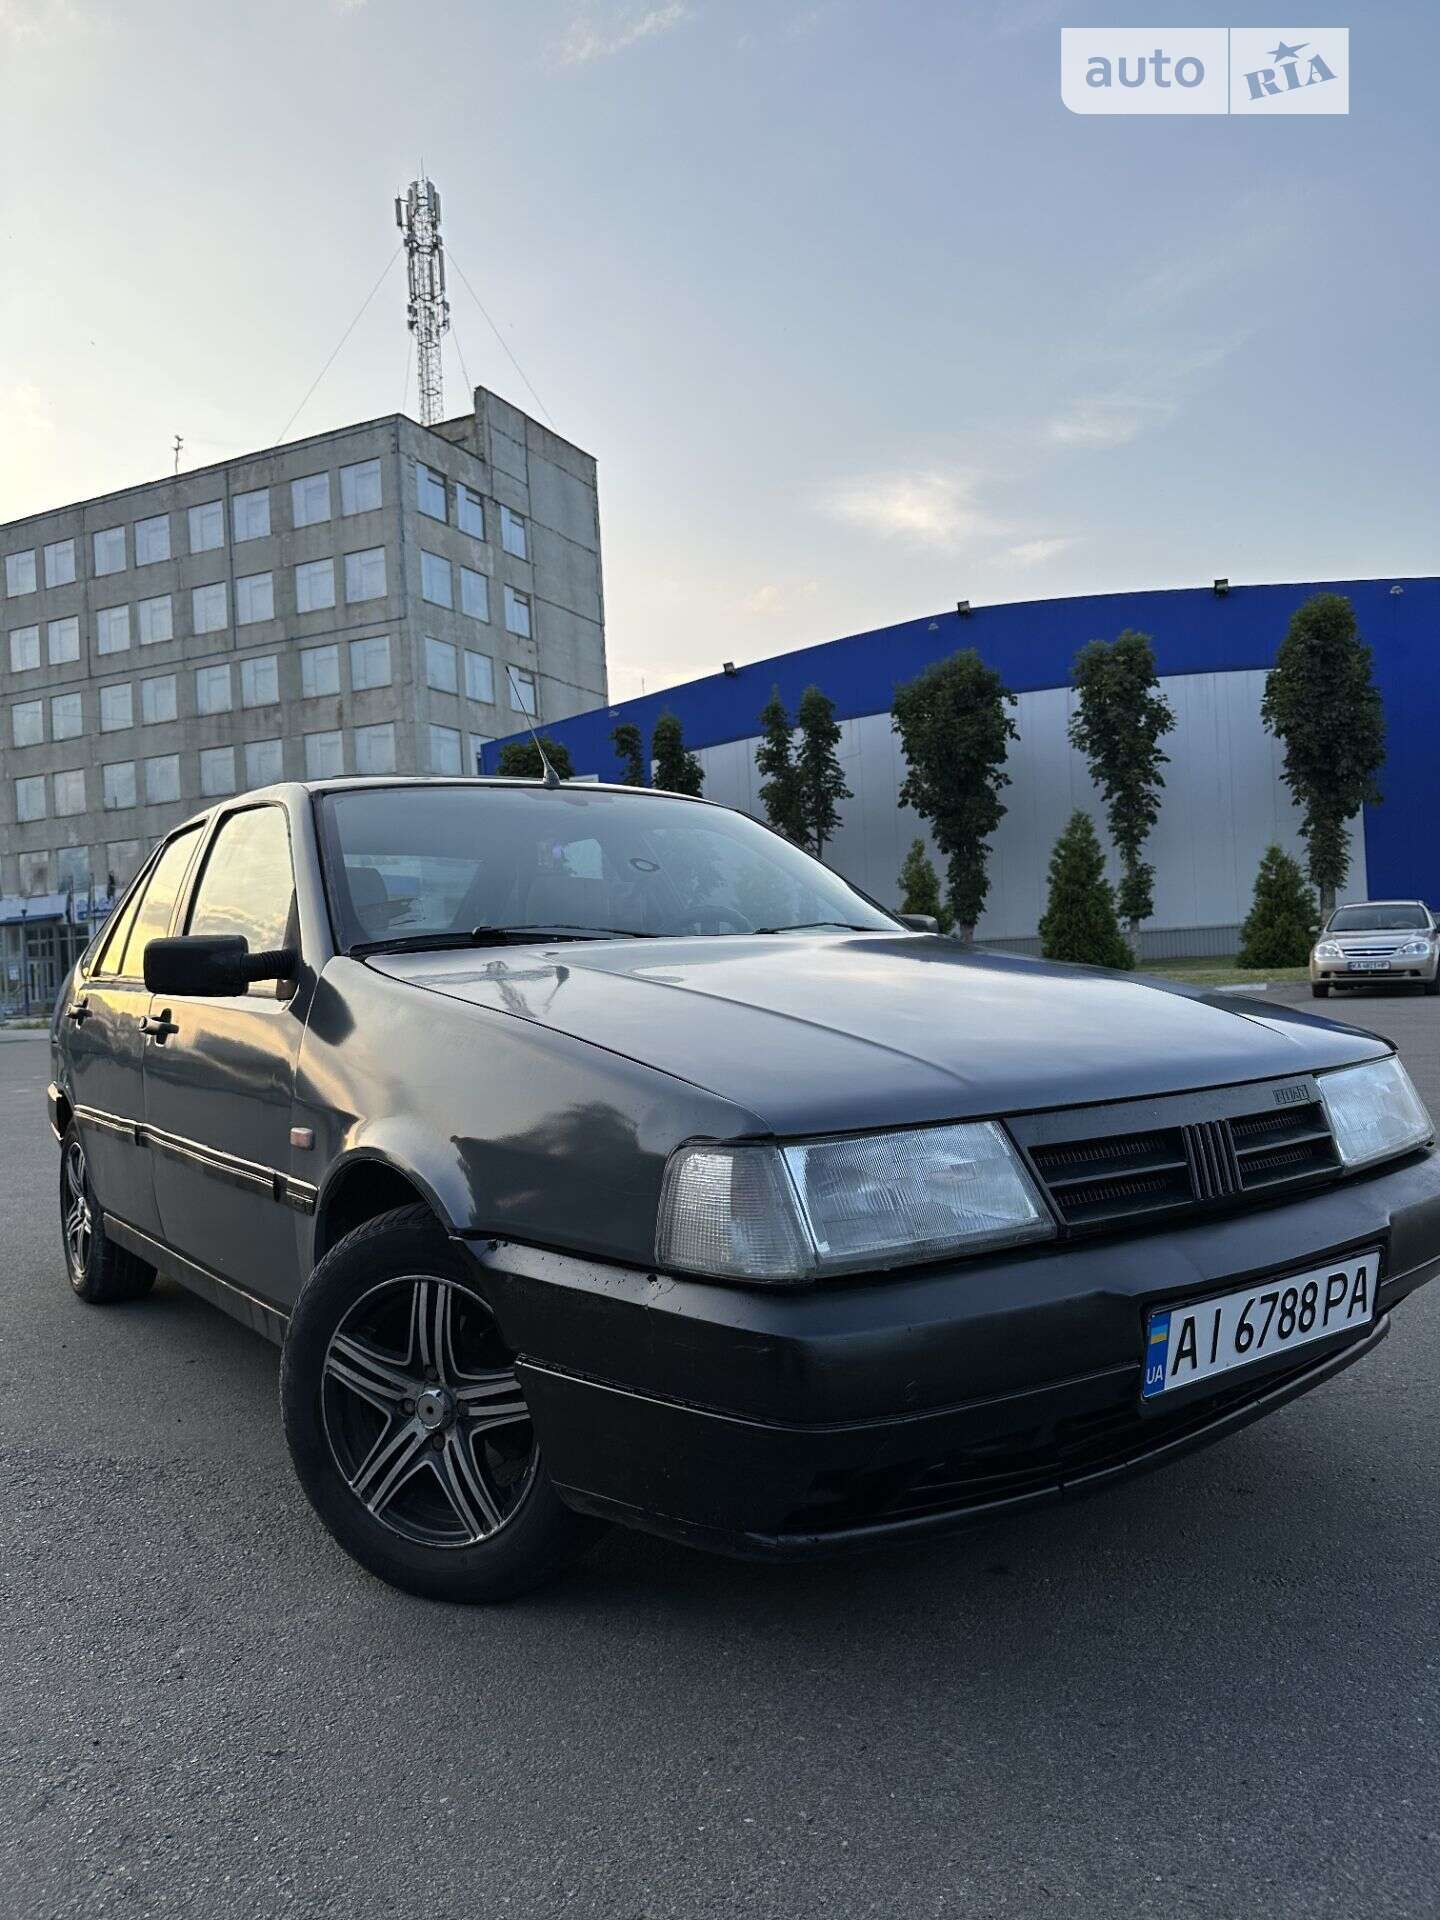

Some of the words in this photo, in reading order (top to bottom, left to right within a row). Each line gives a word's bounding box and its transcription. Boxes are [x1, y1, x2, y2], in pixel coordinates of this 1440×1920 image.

[1171, 1308, 1222, 1376] AI
[1234, 1281, 1319, 1354] 6788
[1322, 1266, 1368, 1327] PA
[1145, 1364, 1163, 1385] UA
